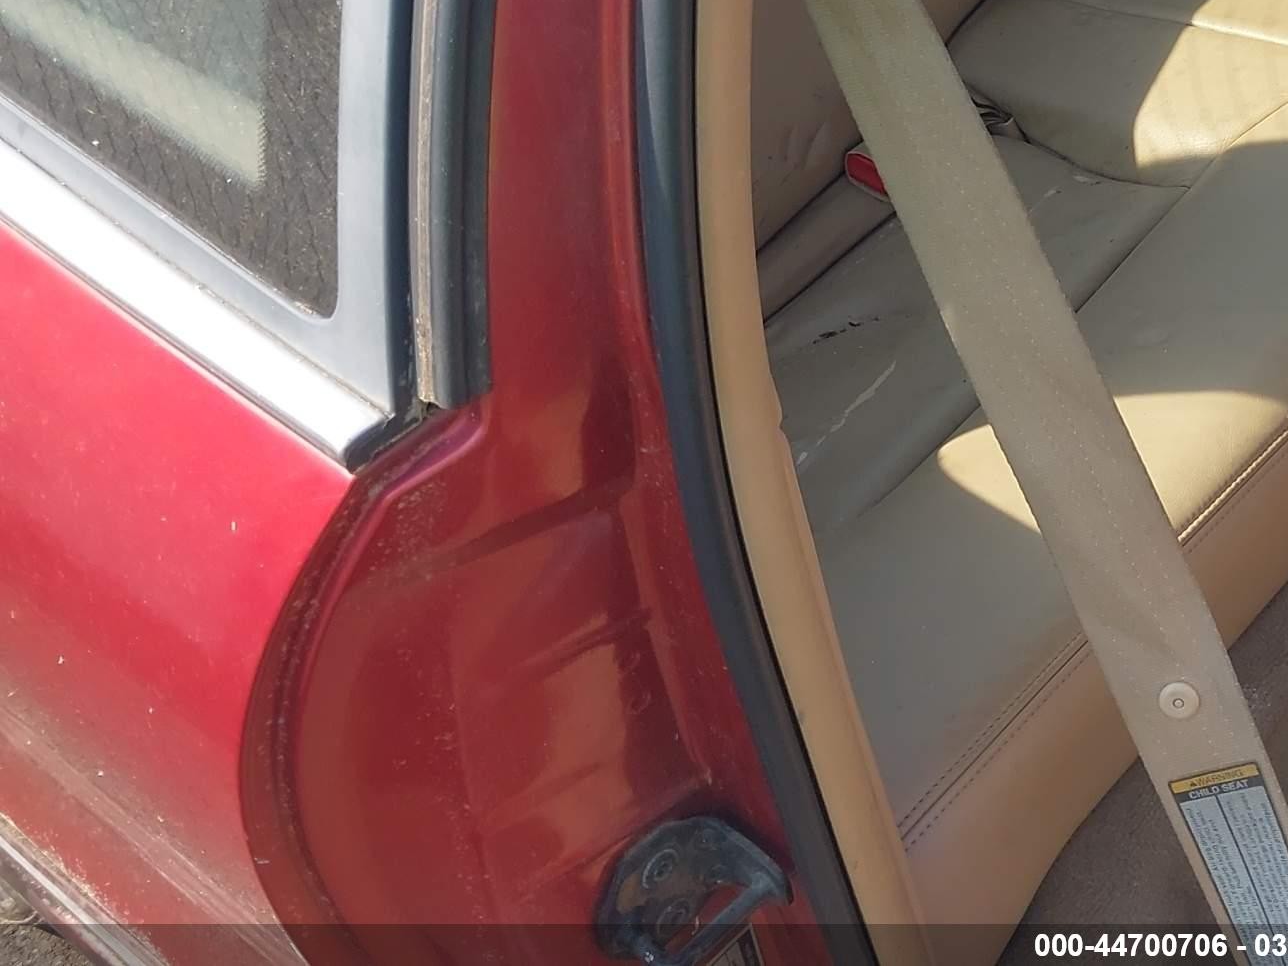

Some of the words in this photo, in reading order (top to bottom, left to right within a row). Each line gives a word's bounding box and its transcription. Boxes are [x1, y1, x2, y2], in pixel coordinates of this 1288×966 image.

[1194, 769, 1244, 787] WARNING
[1188, 785, 1220, 799] CHILD
[1221, 779, 1249, 792] SEAT
